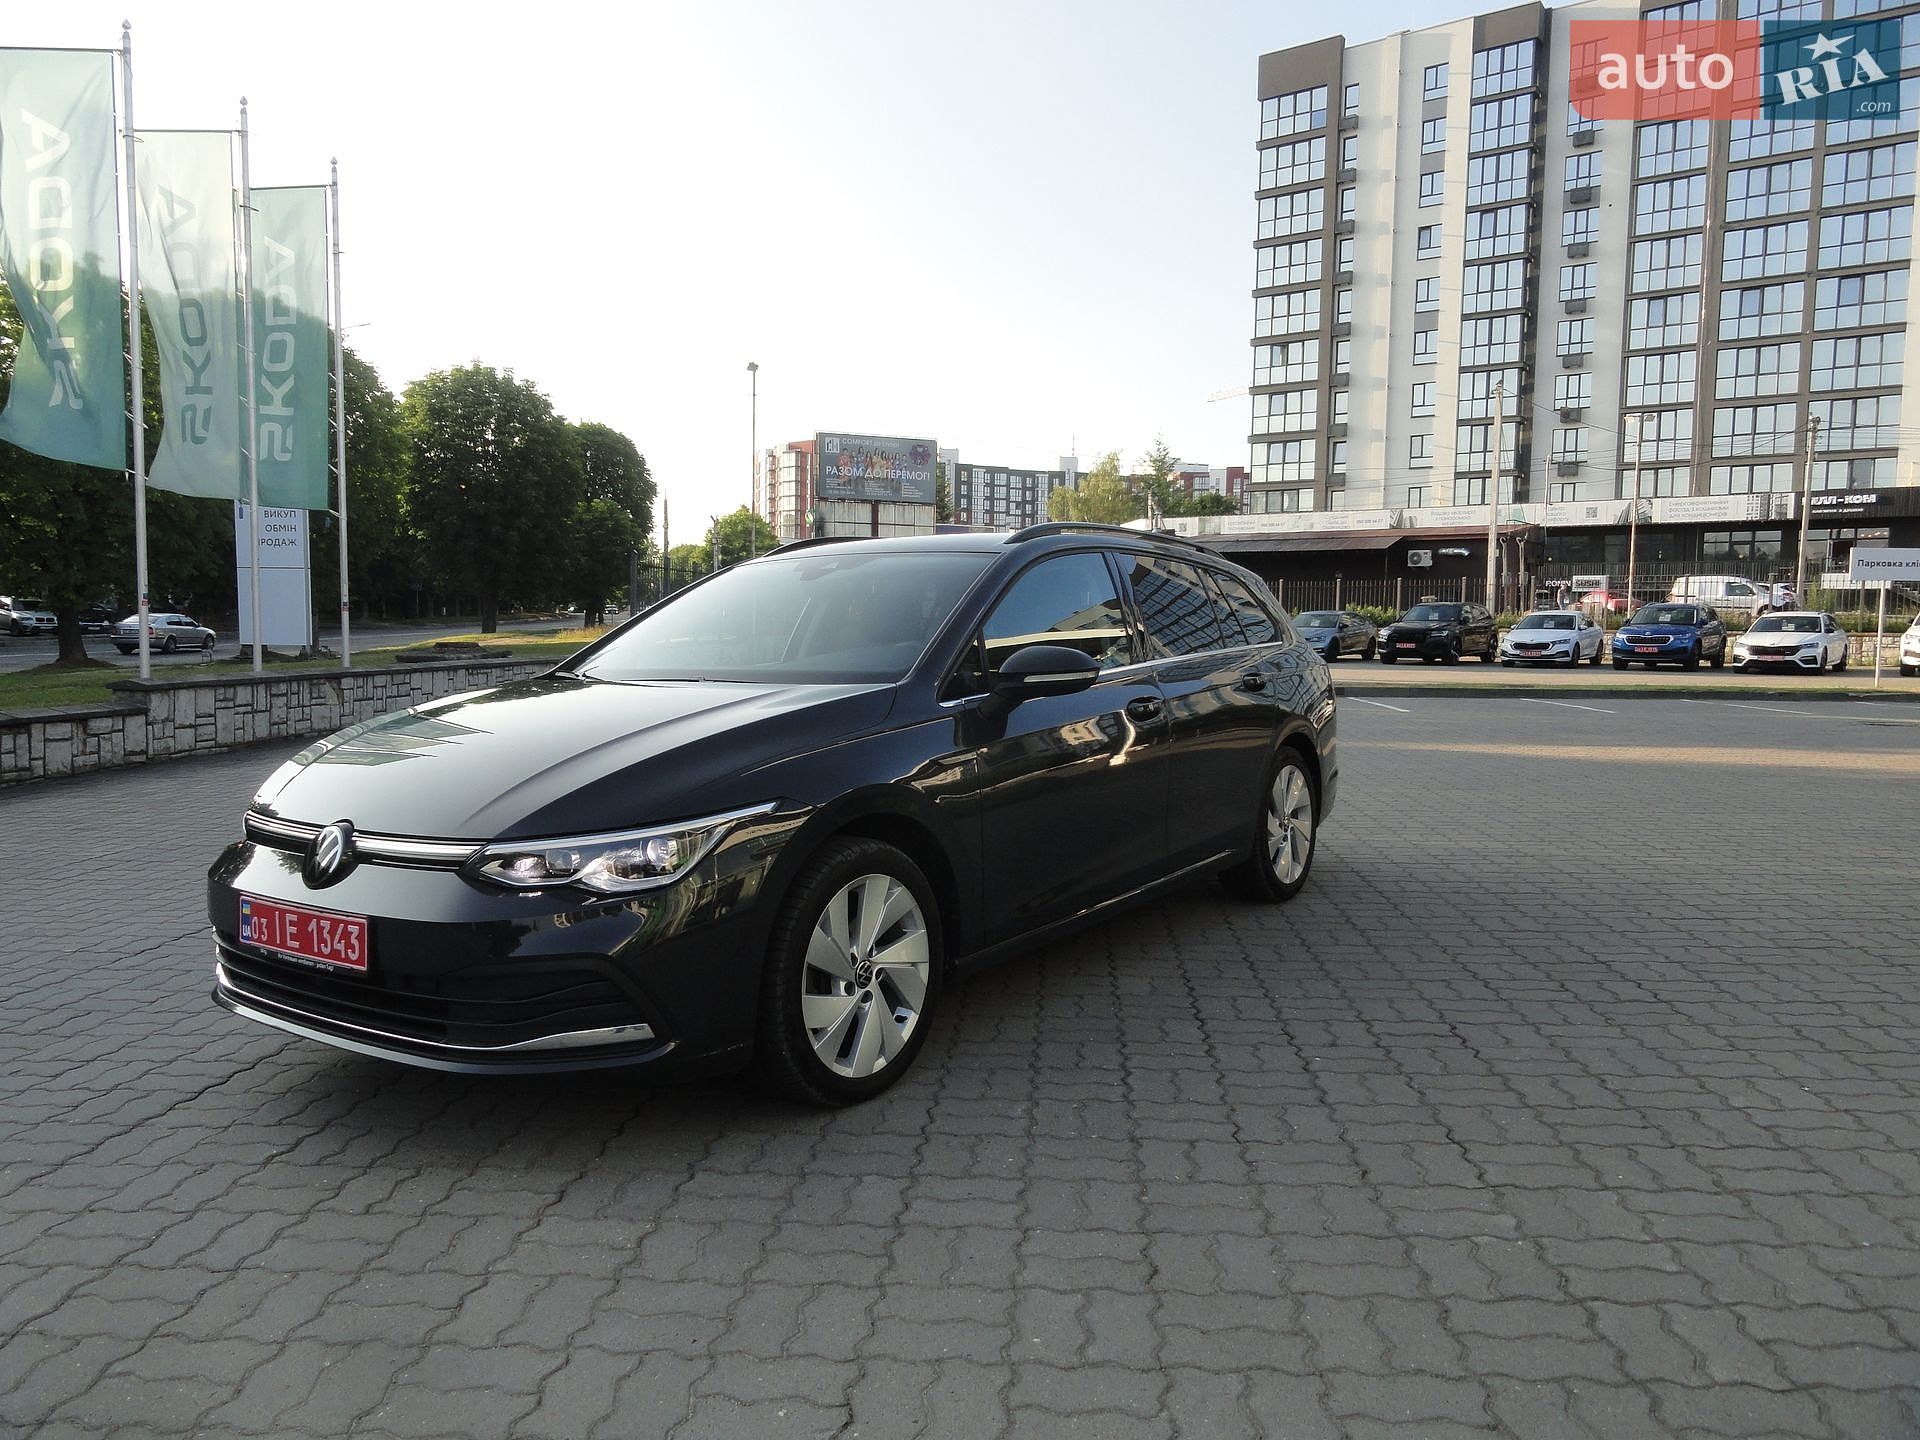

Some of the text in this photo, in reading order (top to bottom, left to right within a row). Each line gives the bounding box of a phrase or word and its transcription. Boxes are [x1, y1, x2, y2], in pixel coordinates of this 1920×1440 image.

[825, 466, 863, 477] РАЗОМ
[865, 468, 883, 479] ДО
[264, 510, 297, 518] ВИКУП
[264, 524, 297, 532] ОБМІН
[1857, 559, 1903, 568] Парковка
[242, 924, 252, 938] UA
[251, 911, 360, 961] 03 IE 1343
